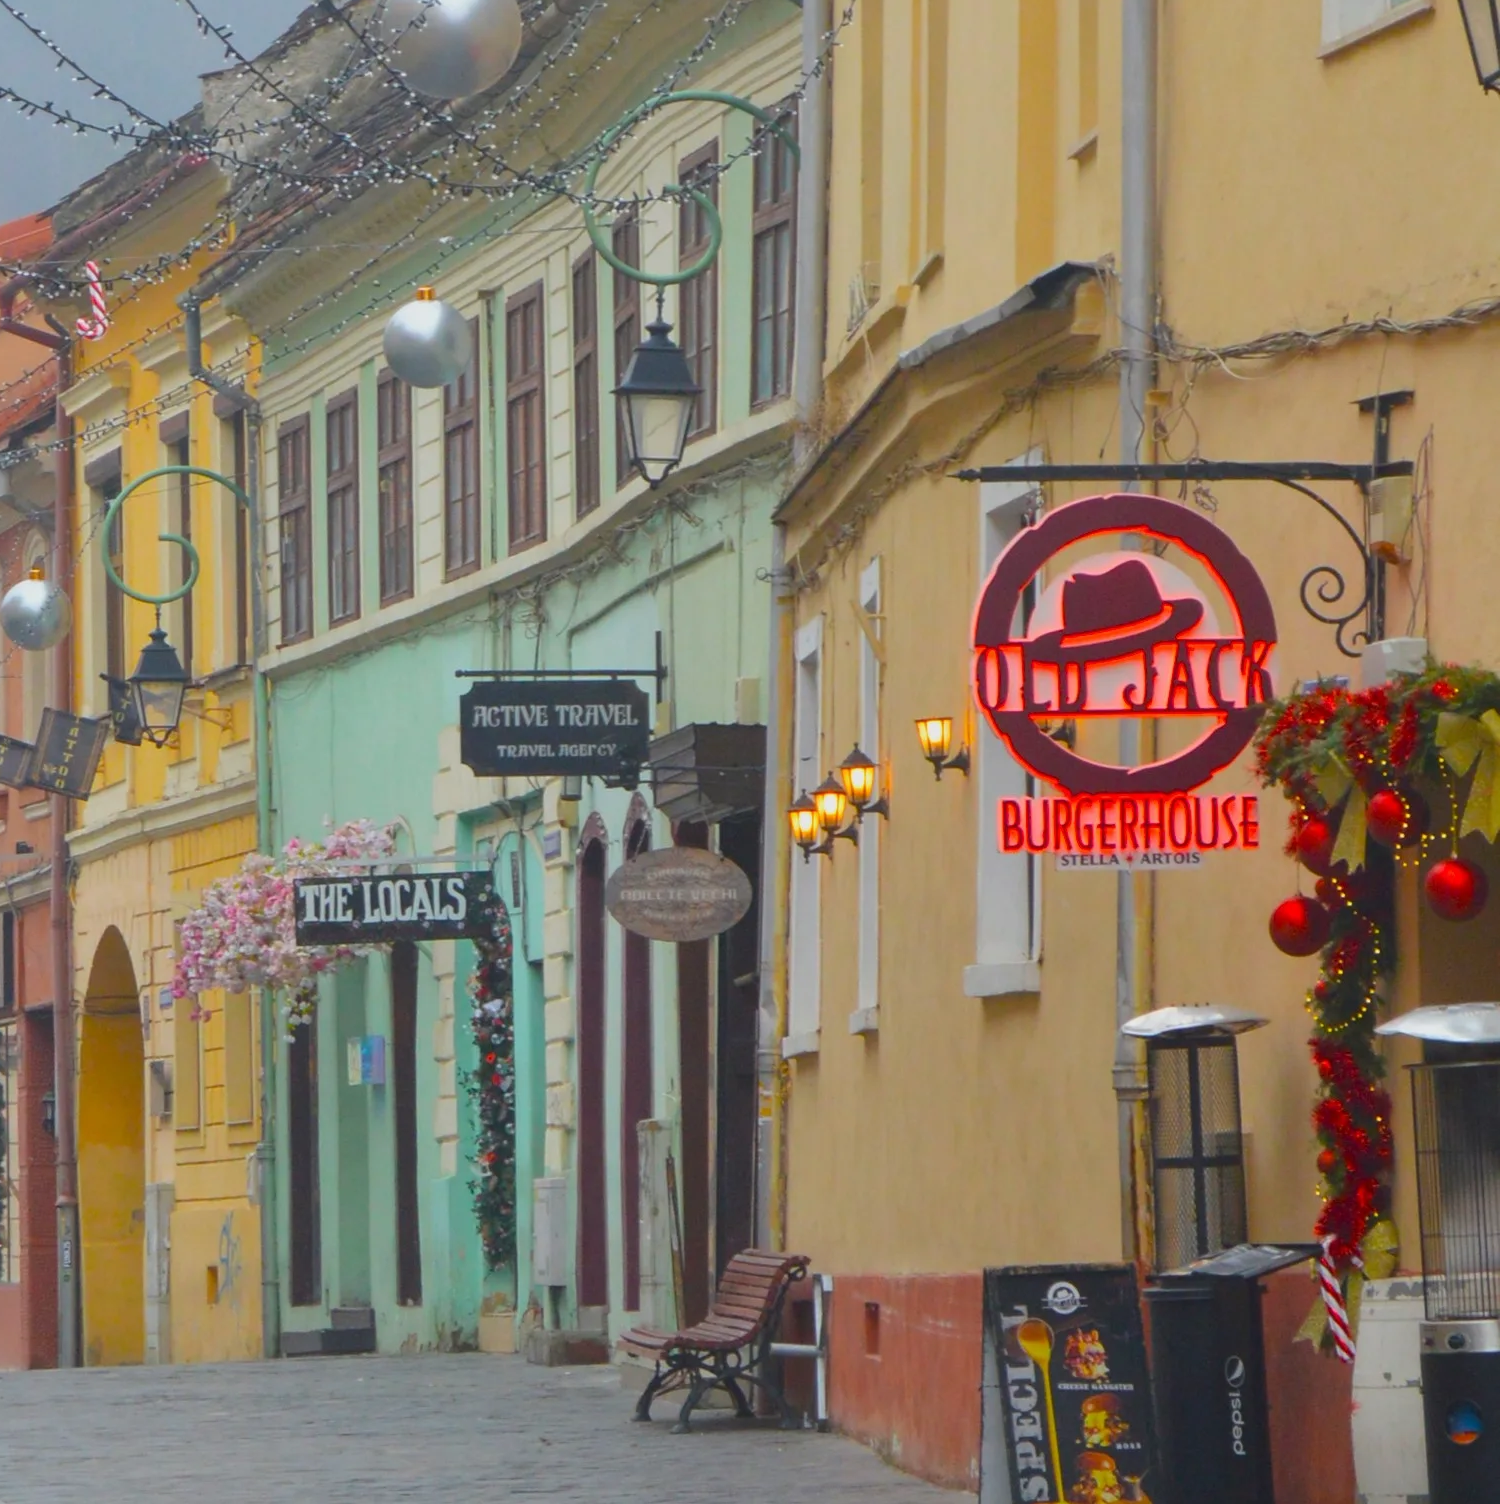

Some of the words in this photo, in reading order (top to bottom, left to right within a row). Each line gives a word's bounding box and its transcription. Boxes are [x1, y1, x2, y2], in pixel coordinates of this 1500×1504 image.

[977, 646, 1086, 712] OLD
[1122, 642, 1276, 710] JACK
[472, 704, 548, 727] ACTIVE
[555, 704, 639, 727] TRAVEL
[497, 744, 555, 758] TRAVEL
[1002, 797, 1260, 852] BURGERHOUSE
[1061, 853, 1120, 866] STELLA
[1140, 852, 1201, 865] ARTOIS
[300, 883, 353, 922] THE
[362, 877, 467, 923] LOCALS
[1001, 1305, 1049, 1502] SPECIL
[1228, 1392, 1246, 1455] pepsi
